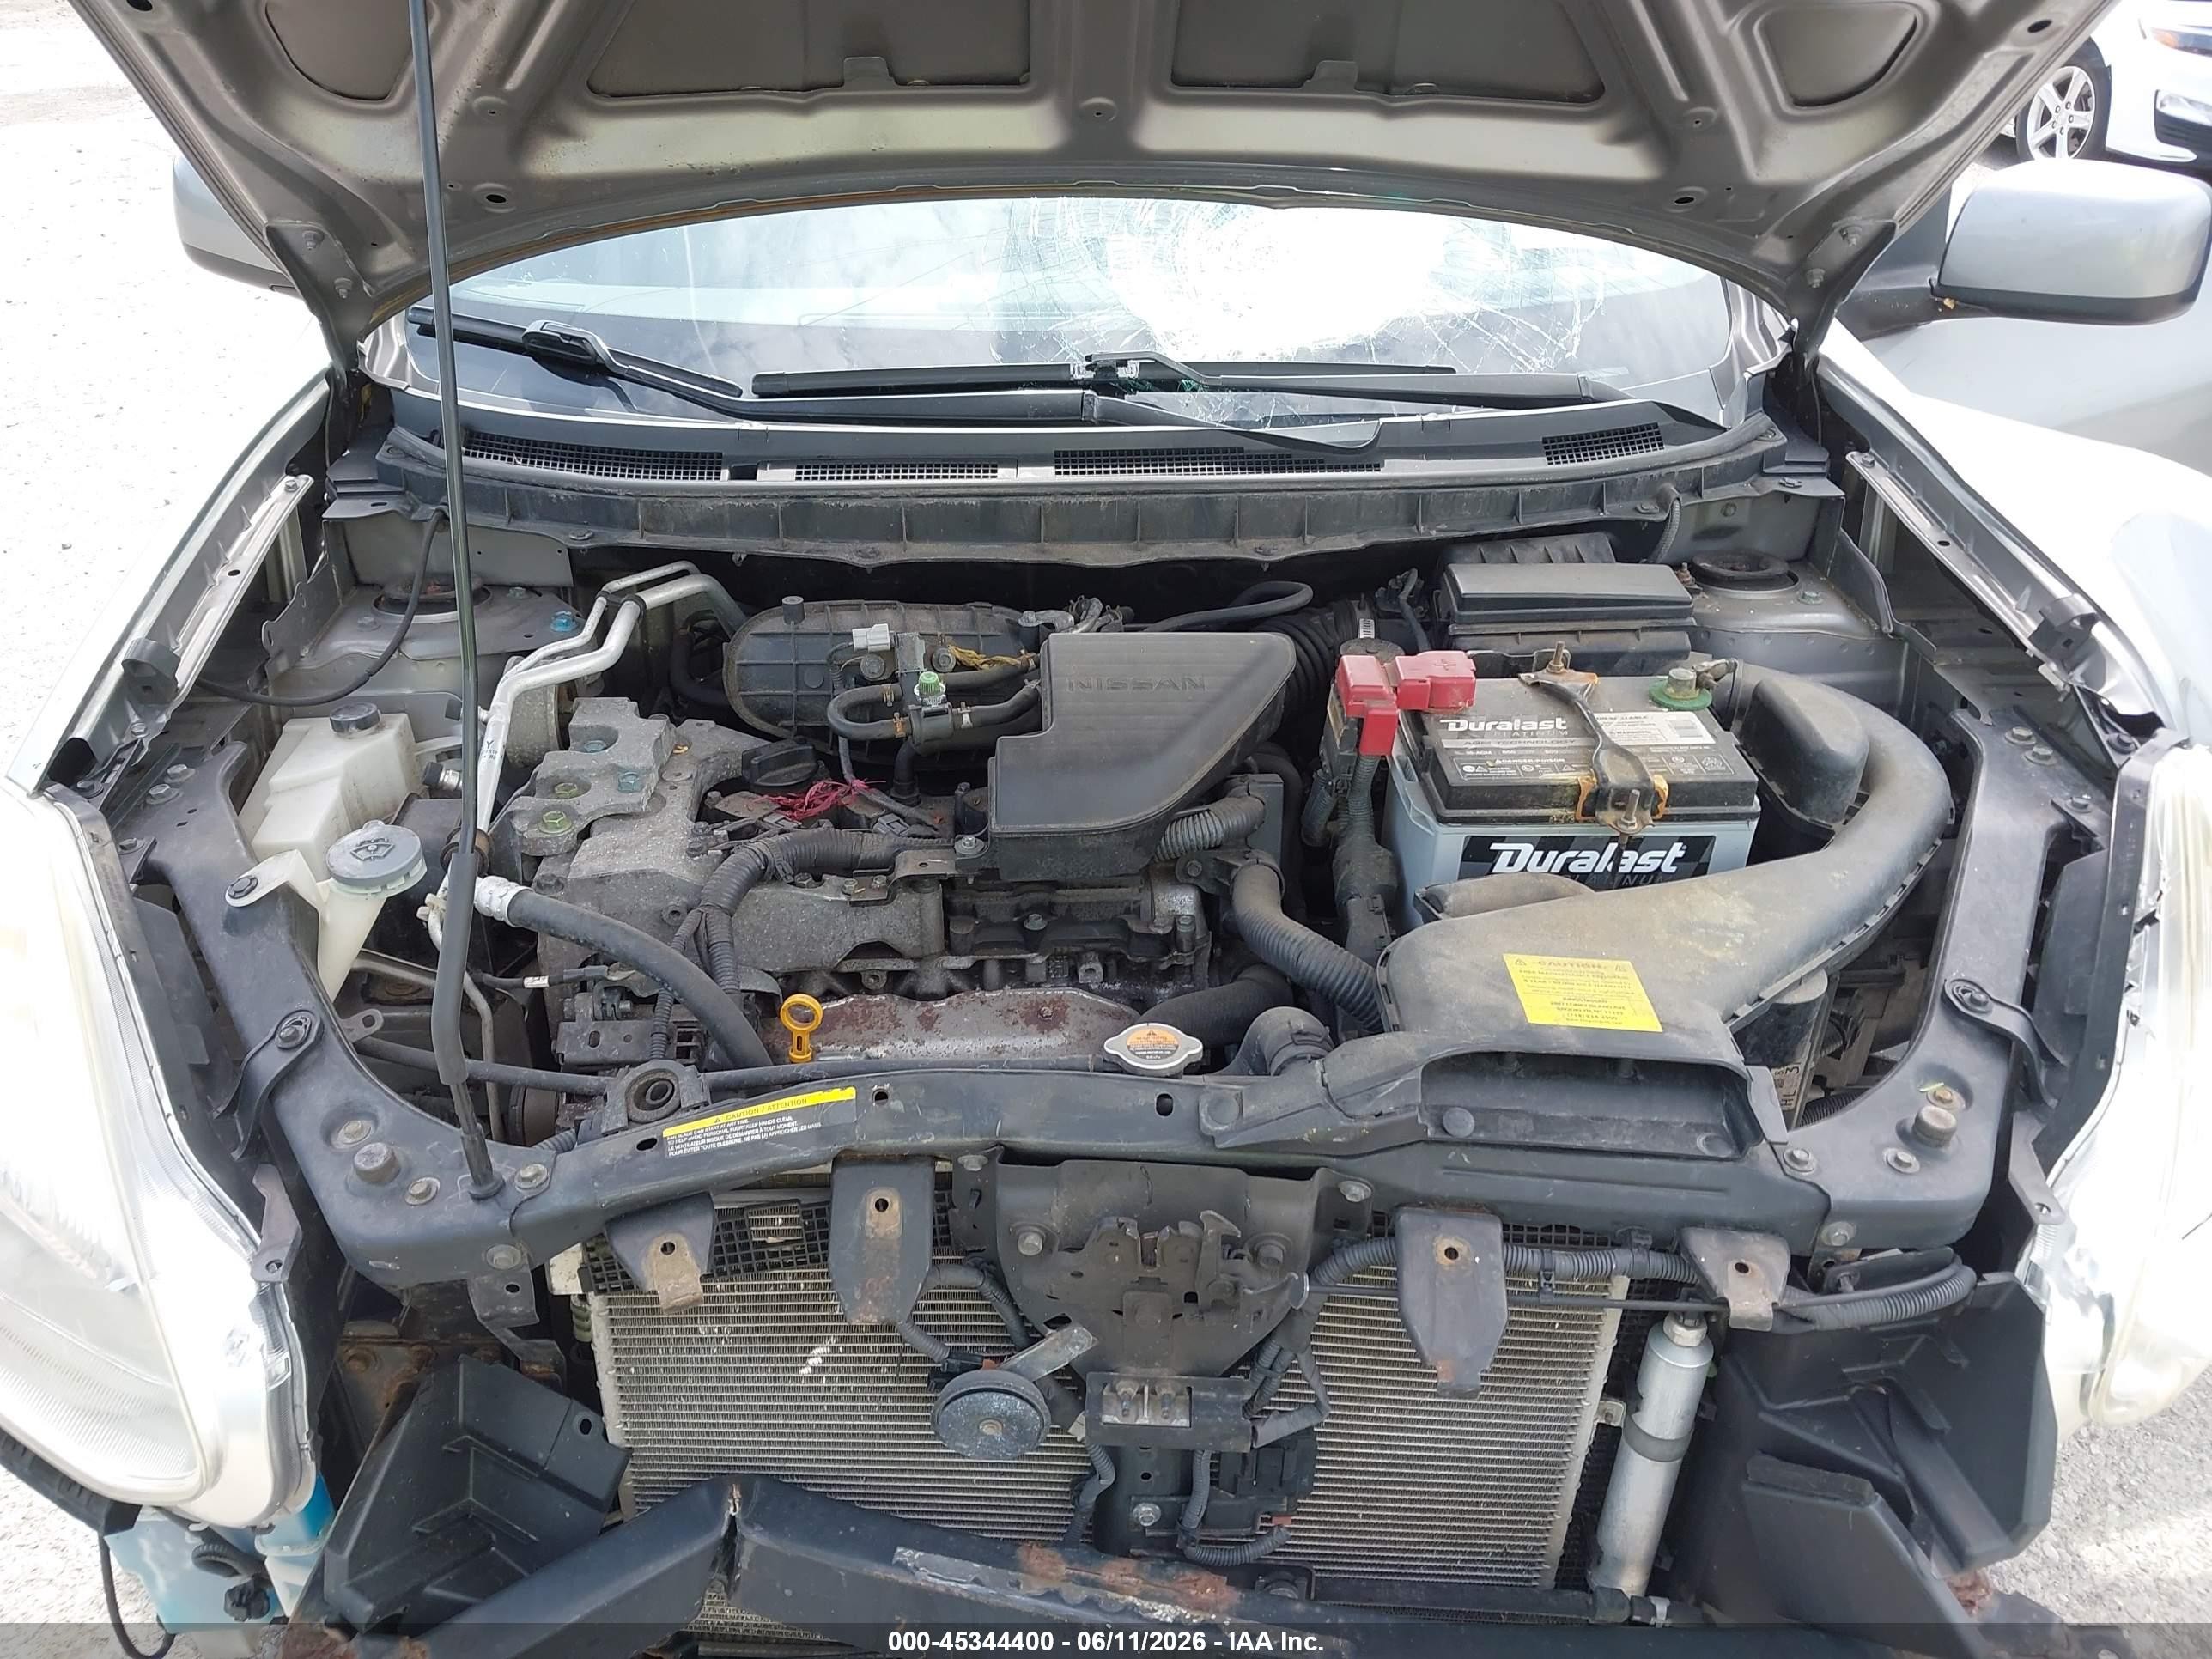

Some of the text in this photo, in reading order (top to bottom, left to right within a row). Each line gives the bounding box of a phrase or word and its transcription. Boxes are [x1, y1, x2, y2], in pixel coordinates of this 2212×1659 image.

[1068, 678, 1206, 692] NISSAN
[1440, 718, 1567, 732] Duralast
[1490, 842, 1684, 873] Duralast
[726, 1108, 760, 1120] CAUTION
[767, 1098, 807, 1111] ATTENTION
